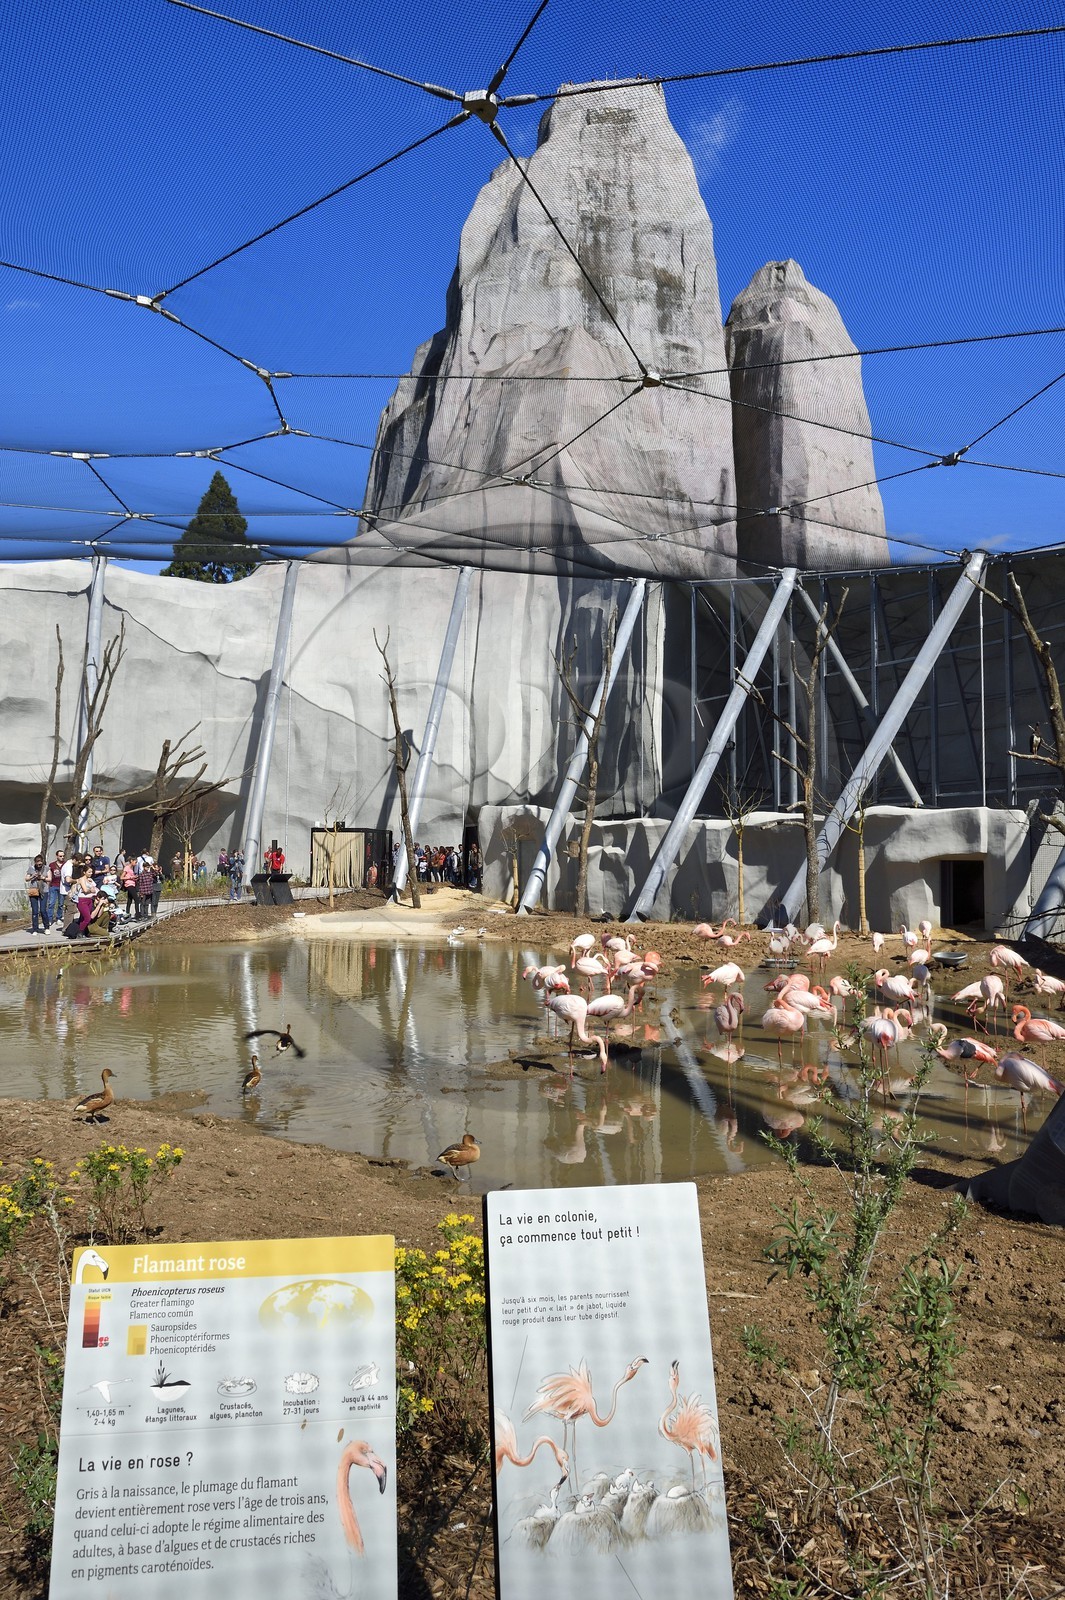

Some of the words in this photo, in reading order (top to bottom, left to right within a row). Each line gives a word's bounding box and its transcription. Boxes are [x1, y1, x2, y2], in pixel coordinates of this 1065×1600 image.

[500, 1214, 512, 1225] La
[517, 1212, 533, 1224] vie
[538, 1213, 550, 1223] en
[555, 1210, 597, 1223] colonie,
[500, 1234, 513, 1247] ça
[517, 1230, 576, 1243] commence
[581, 1228, 602, 1240] tout
[607, 1227, 632, 1241] petit
[637, 1227, 640, 1237] !
[132, 1255, 204, 1274] Flamant
[209, 1256, 246, 1271] rose
[131, 1286, 195, 1298] Phoenicopterus
[198, 1284, 225, 1295] roseus
[502, 1295, 525, 1306] Jusqu'à
[528, 1295, 536, 1303] six
[539, 1295, 555, 1303] mois,
[558, 1294, 567, 1302] les
[570, 1292, 592, 1302] parents
[595, 1290, 629, 1299] nourrissent
[130, 1299, 158, 1308] Greater
[161, 1297, 194, 1308] flamingo
[502, 1307, 514, 1315] leur
[517, 1305, 531, 1315] petit
[534, 1305, 546, 1313] d'un
[577, 1303, 584, 1311] de
[586, 1302, 603, 1312] jabot,
[606, 1300, 626, 1310] liquide
[129, 1310, 165, 1320] Flamenco
[167, 1309, 193, 1318] común
[502, 1318, 519, 1327] rouge
[522, 1315, 544, 1325] produit
[547, 1315, 562, 1323] dans
[564, 1313, 576, 1322] leur
[579, 1313, 592, 1321] tube
[595, 1311, 619, 1321] digestif.
[151, 1322, 197, 1334] Sauropsides
[150, 1331, 230, 1345] Phoenicoptériformes
[149, 1343, 216, 1356] Phoenicoptéridés
[283, 1398, 316, 1406] Incubation
[342, 1395, 365, 1404] Jusqu'à
[158, 1407, 185, 1415] Lagunes,
[209, 1411, 231, 1420] algues,
[234, 1409, 263, 1419] plancton
[303, 1407, 319, 1416] jours
[108, 1418, 115, 1426] kg
[145, 1416, 167, 1424] étangs
[79, 1458, 95, 1472] La
[102, 1456, 122, 1471] vie
[128, 1457, 143, 1469] en
[149, 1455, 180, 1468] rose
[186, 1452, 193, 1466] ?
[76, 1488, 99, 1500] Gris
[102, 1486, 108, 1499] à
[111, 1486, 119, 1498] la
[123, 1483, 178, 1498] naissance,
[181, 1482, 190, 1494] le
[193, 1480, 238, 1496] plumage
[241, 1479, 254, 1491] du
[256, 1476, 298, 1490] flamant
[75, 1507, 116, 1519] devient
[118, 1502, 185, 1517] entièrement
[187, 1502, 210, 1513] rose
[213, 1500, 235, 1511] vers
[238, 1497, 263, 1512] l'âge
[265, 1495, 278, 1507] de
[280, 1494, 304, 1506] trois
[307, 1494, 329, 1505] ans,
[74, 1526, 108, 1541] quand
[111, 1521, 149, 1536] celui-ci
[152, 1519, 189, 1535] adopte
[191, 1519, 201, 1531] le
[204, 1517, 240, 1533] régime
[243, 1514, 304, 1528] alimentaire
[307, 1512, 325, 1523] des
[72, 1545, 115, 1559] adultes,
[118, 1543, 124, 1555] à
[127, 1541, 152, 1554] base
[154, 1539, 198, 1555] d'algues
[201, 1539, 212, 1550] et
[215, 1537, 227, 1549] de
[230, 1532, 281, 1548] crustacés
[284, 1531, 315, 1544] riches
[71, 1567, 85, 1579] en
[87, 1563, 139, 1581] pigments
[141, 1557, 214, 1574] caroténoïdes.
